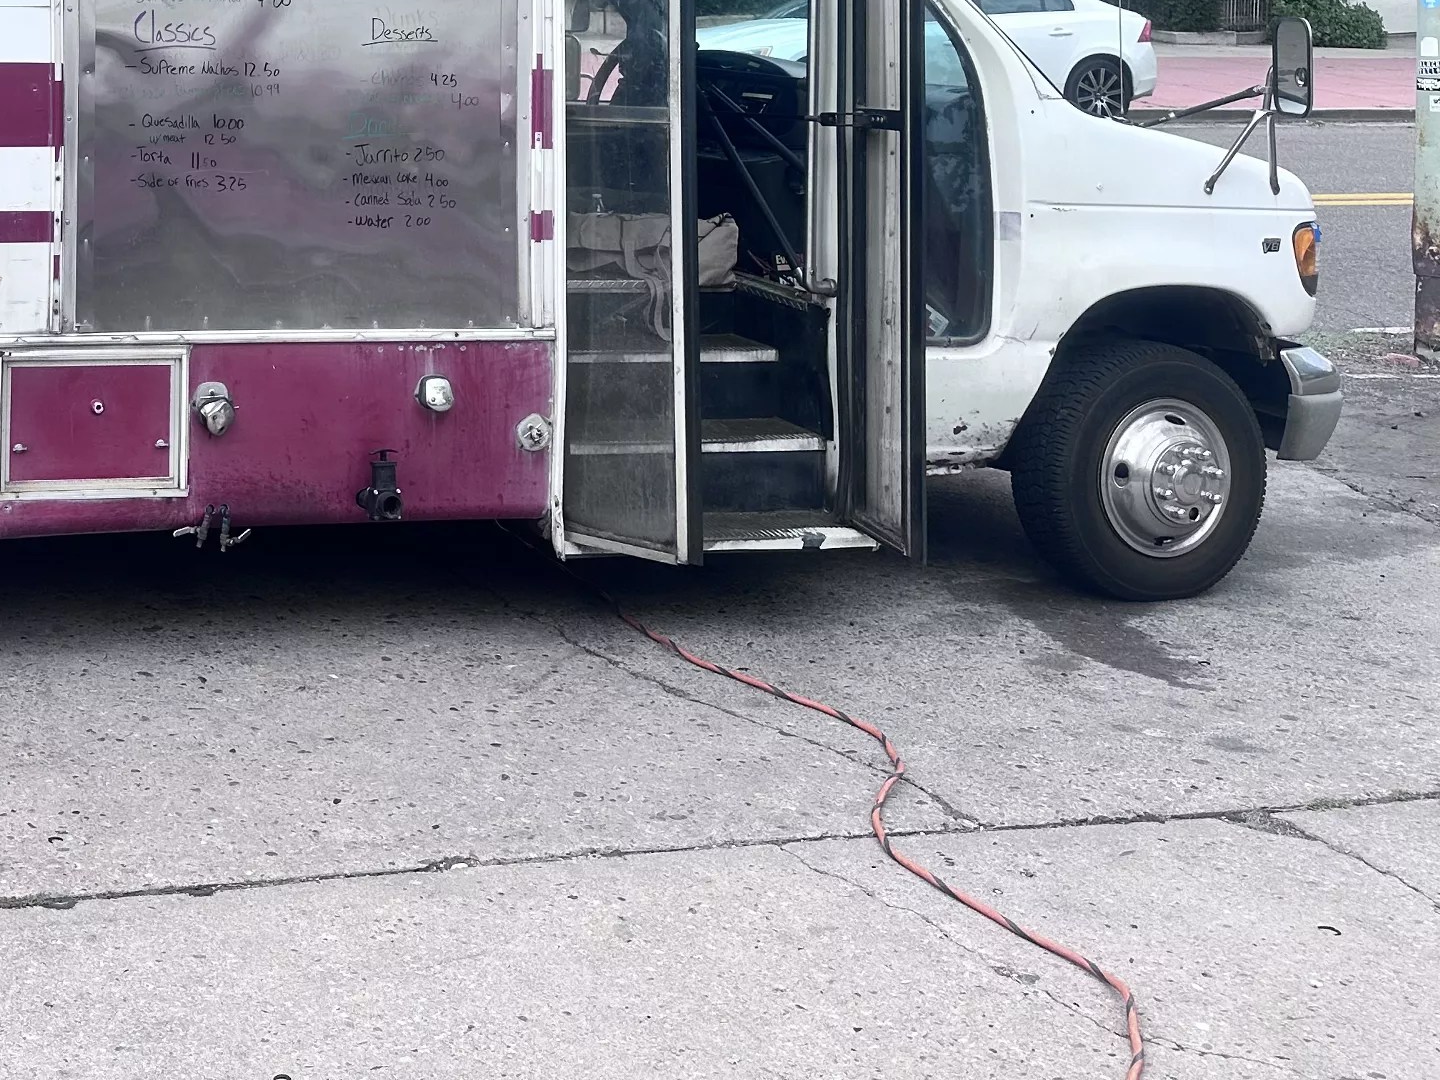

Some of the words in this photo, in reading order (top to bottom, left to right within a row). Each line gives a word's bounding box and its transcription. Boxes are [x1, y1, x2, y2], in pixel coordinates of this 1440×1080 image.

[134, 9, 216, 46] Classics
[371, 17, 433, 41] Desserts
[200, 59, 240, 77] Nachos
[141, 113, 201, 130] Quesadilla
[163, 135, 187, 144] meat
[353, 143, 409, 167] Jarrito
[354, 191, 390, 207] Canned
